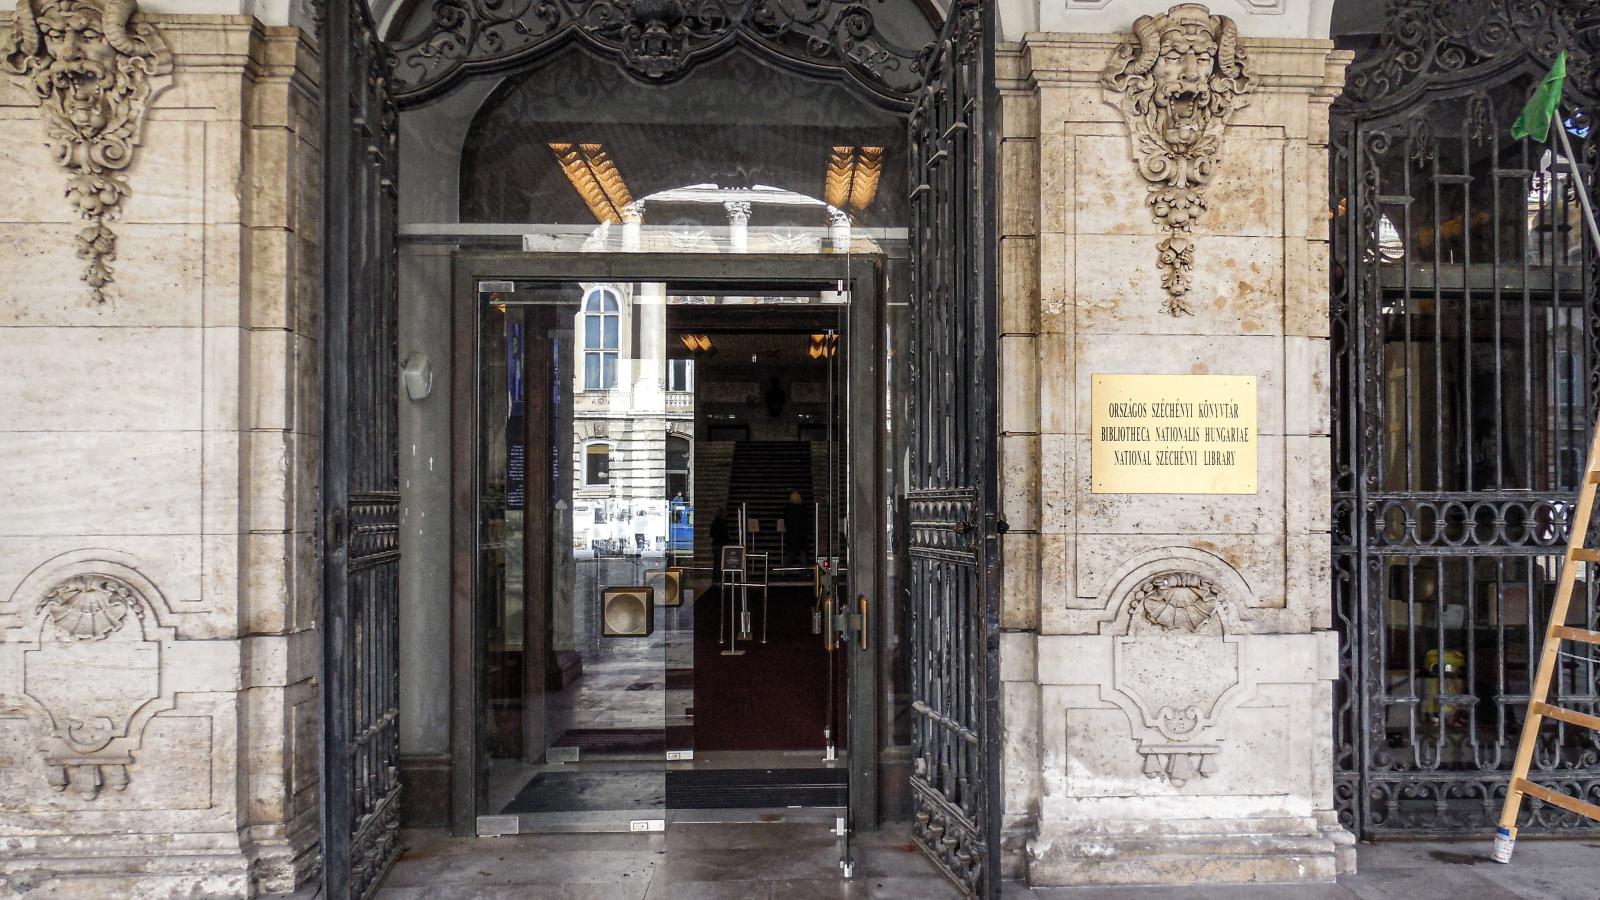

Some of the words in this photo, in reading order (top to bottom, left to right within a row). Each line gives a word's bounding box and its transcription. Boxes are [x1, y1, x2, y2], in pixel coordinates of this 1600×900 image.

[1109, 398, 1147, 418] ORSZÁGOS
[1151, 398, 1193, 418] SZÉCHÉNYI
[1198, 398, 1239, 419] KÖNYVTÁR
[1101, 426, 1150, 442] BIBLIOTHECA
[1155, 427, 1200, 442] NATIONALIS
[1205, 427, 1249, 442] HUNGARIAE
[1114, 450, 1151, 466] NATIONAL
[1156, 446, 1197, 466] SZÉCHÉNYI
[1204, 450, 1236, 466] LIBRARY
